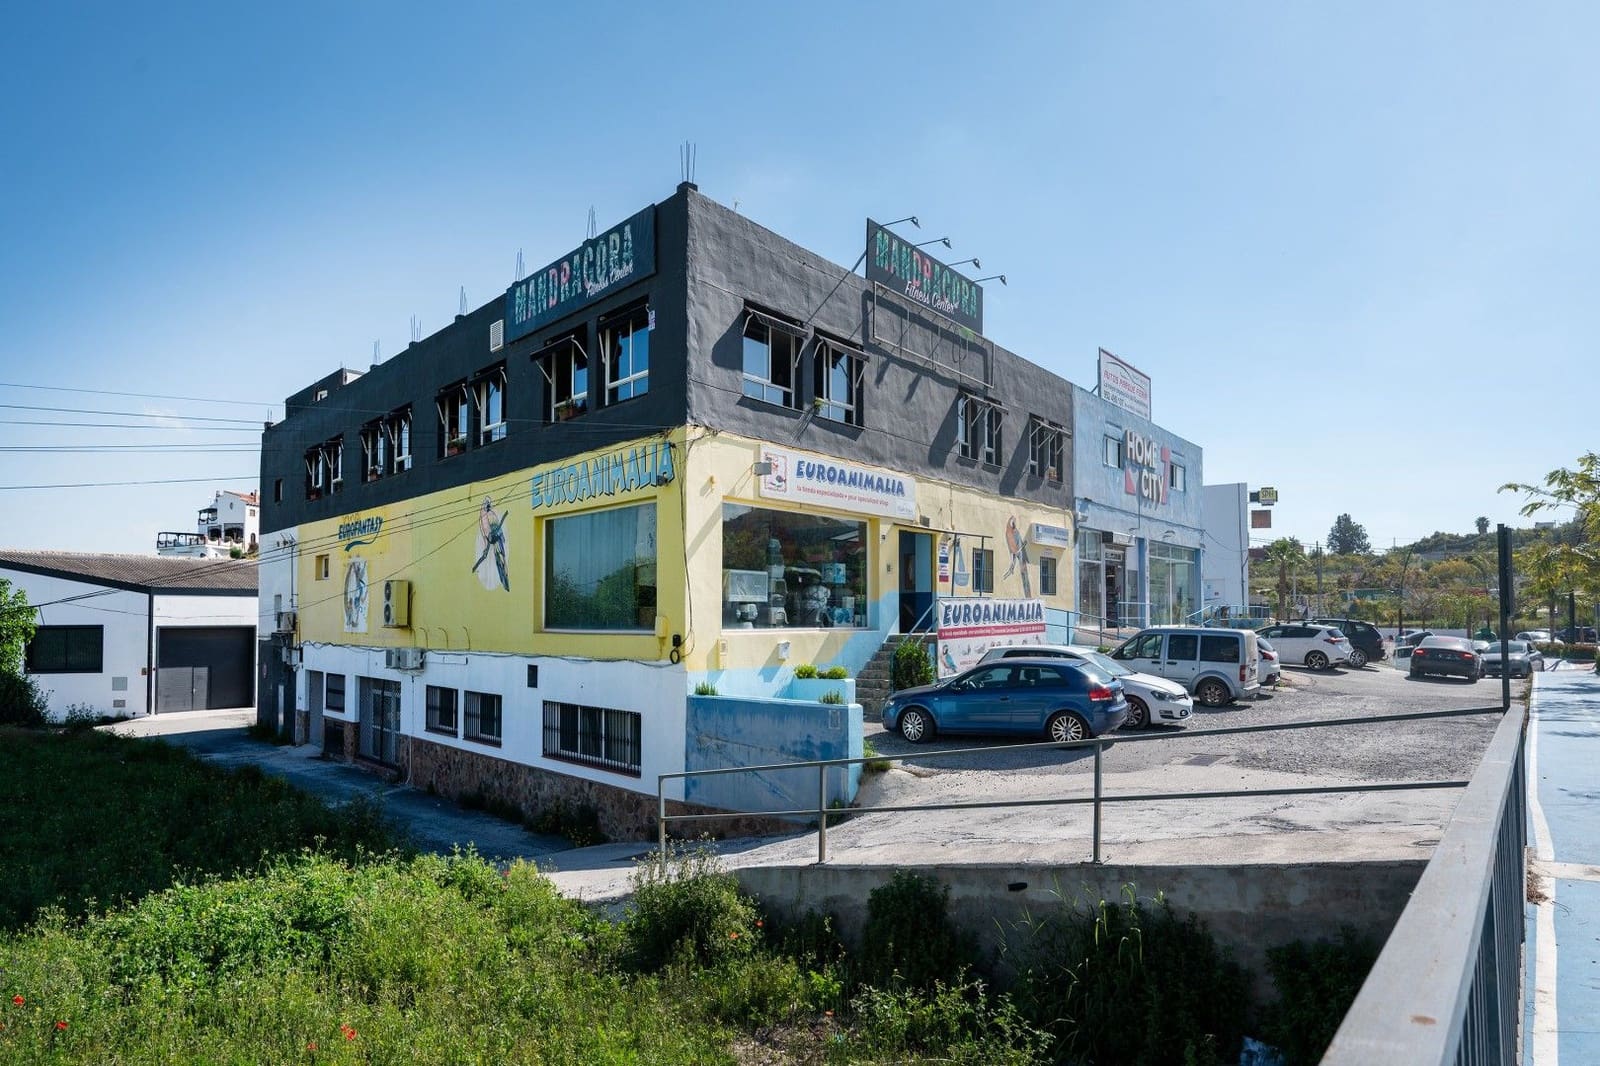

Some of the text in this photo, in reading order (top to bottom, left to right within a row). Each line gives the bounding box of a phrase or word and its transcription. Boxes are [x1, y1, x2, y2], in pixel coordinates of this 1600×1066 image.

[610, 259, 634, 284] Center
[905, 281, 930, 304] Fitness
[931, 293, 955, 315] Center
[1125, 430, 1157, 469] HOME
[531, 440, 676, 510] EUROANIMALIA
[796, 460, 906, 497] EUROANIMALIA
[1141, 469, 1164, 506] CITY
[338, 516, 384, 540] EUROFANTASY
[942, 602, 1043, 627] EUROANIMALIA
